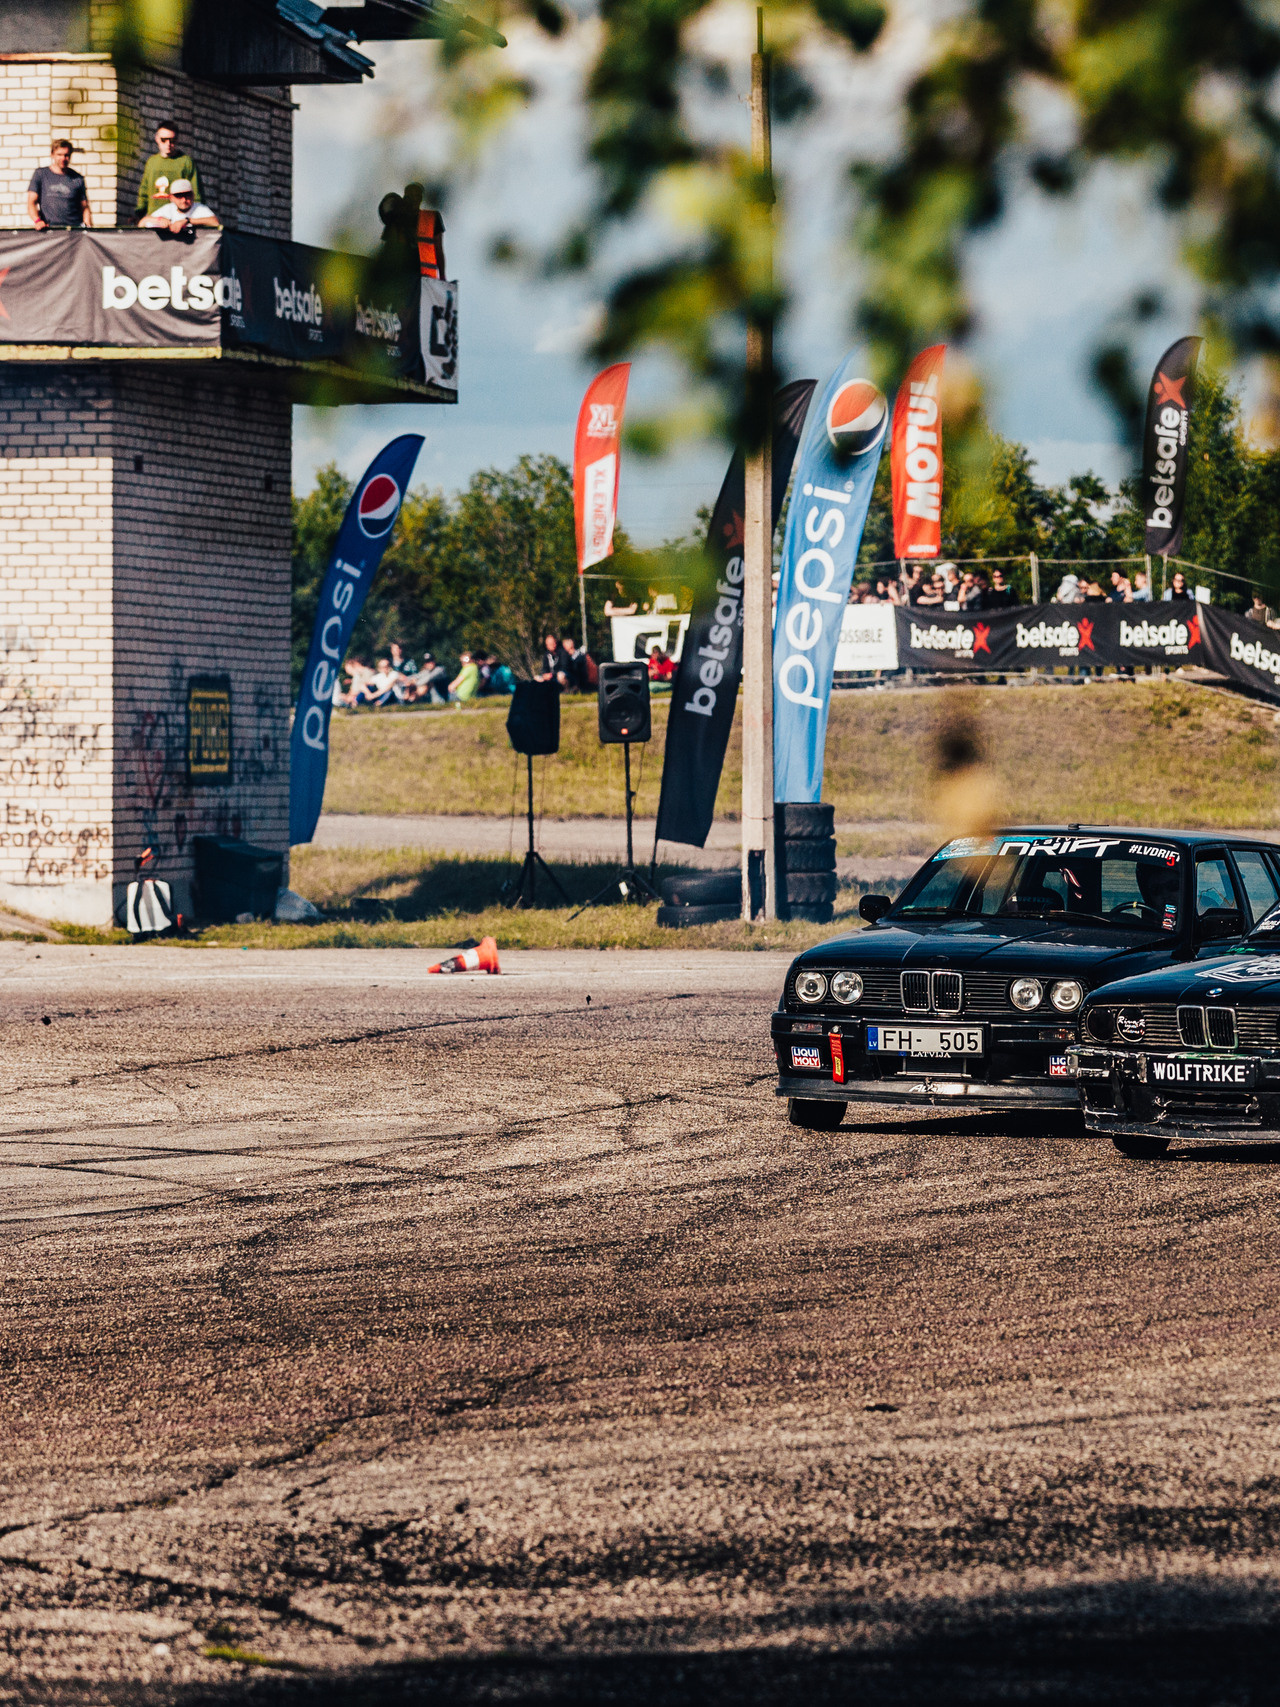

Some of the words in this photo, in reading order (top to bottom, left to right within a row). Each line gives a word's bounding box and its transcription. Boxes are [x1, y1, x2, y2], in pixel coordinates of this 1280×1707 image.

[271, 276, 323, 326] betsafe
[905, 373, 940, 522] MOTUL
[1146, 407, 1181, 529] betsafe
[779, 482, 852, 709] pepsi
[683, 556, 744, 717] betsafe
[910, 622, 974, 649] betsafe
[1016, 620, 1080, 648] betsafe
[1120, 619, 1188, 648] betsafe
[793, 1046, 819, 1058] LIQUI
[940, 1031, 979, 1051] 505
[793, 1057, 820, 1067] MOLY
[1153, 1062, 1246, 1082] WOLFTRIKE
